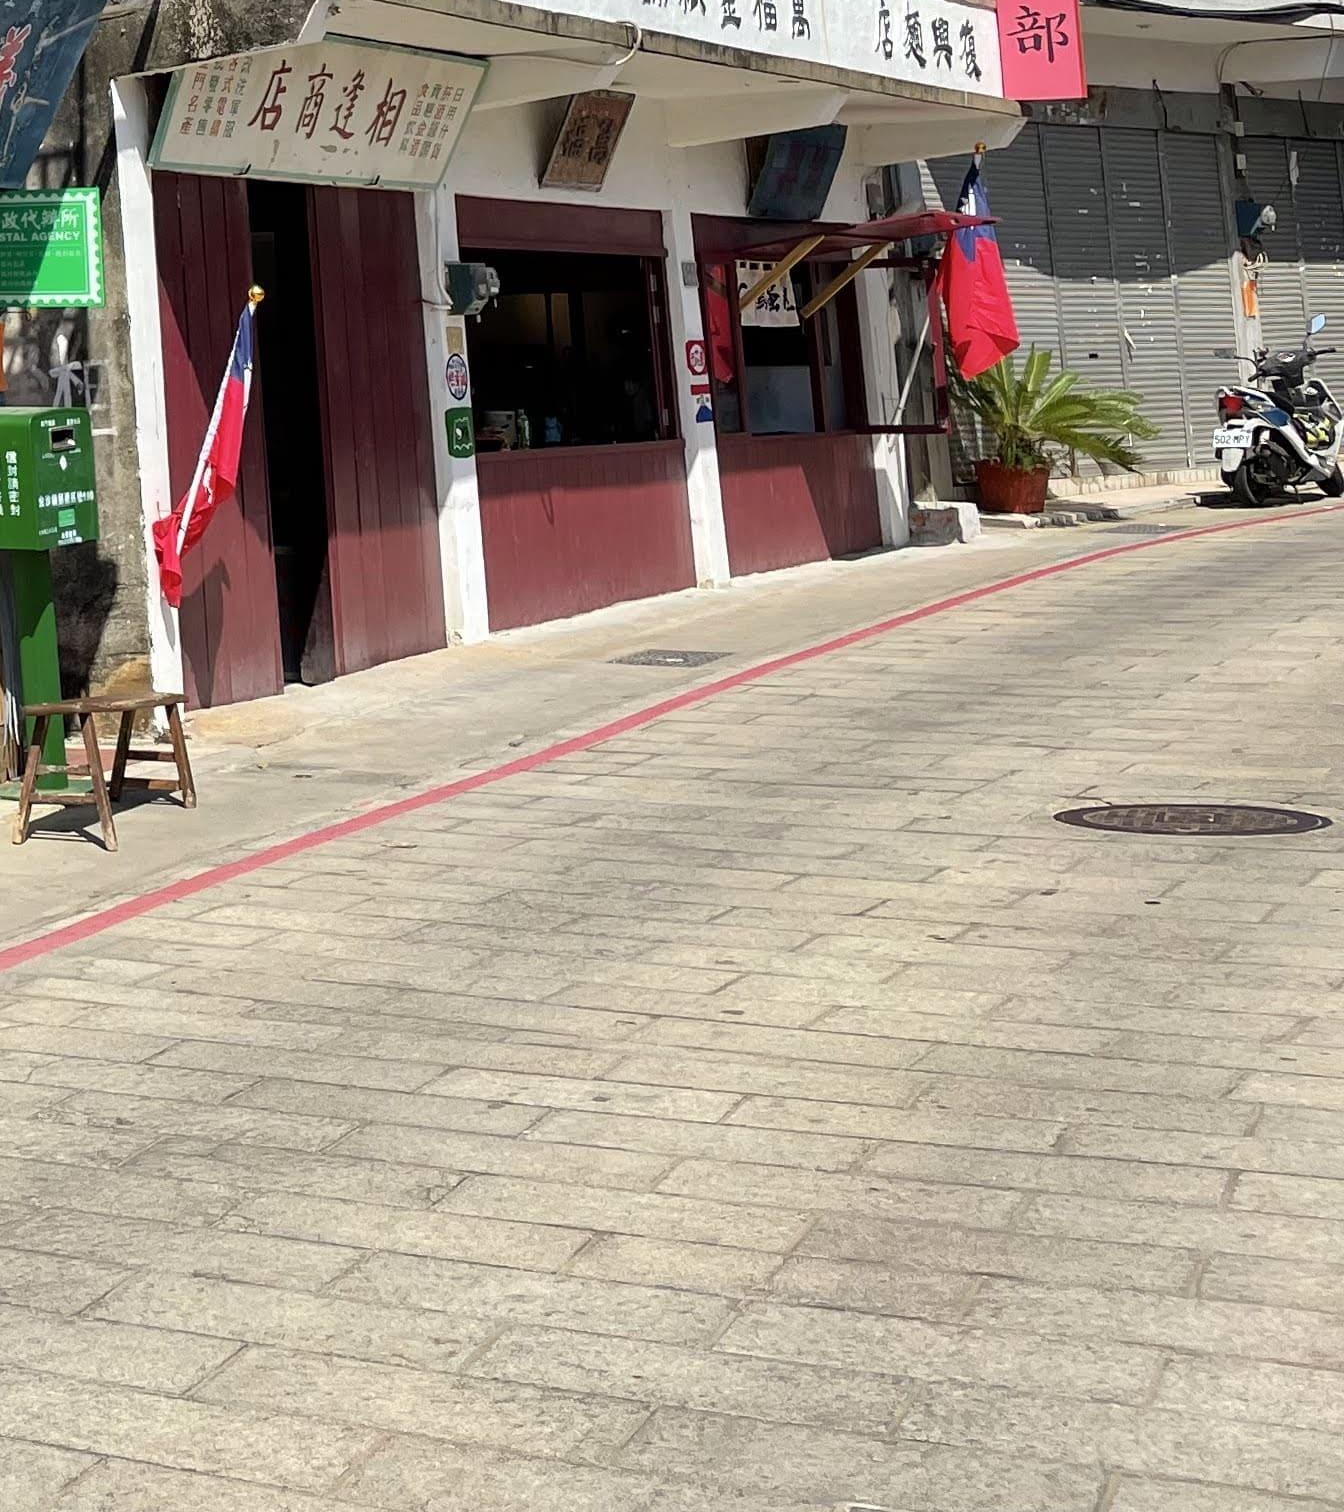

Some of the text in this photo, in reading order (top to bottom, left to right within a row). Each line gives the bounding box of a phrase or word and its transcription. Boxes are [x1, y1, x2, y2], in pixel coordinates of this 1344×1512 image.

[179, 64, 209, 135] 門名產
[248, 59, 407, 148] 相逢商店
[31, 231, 80, 241] AGENCY
